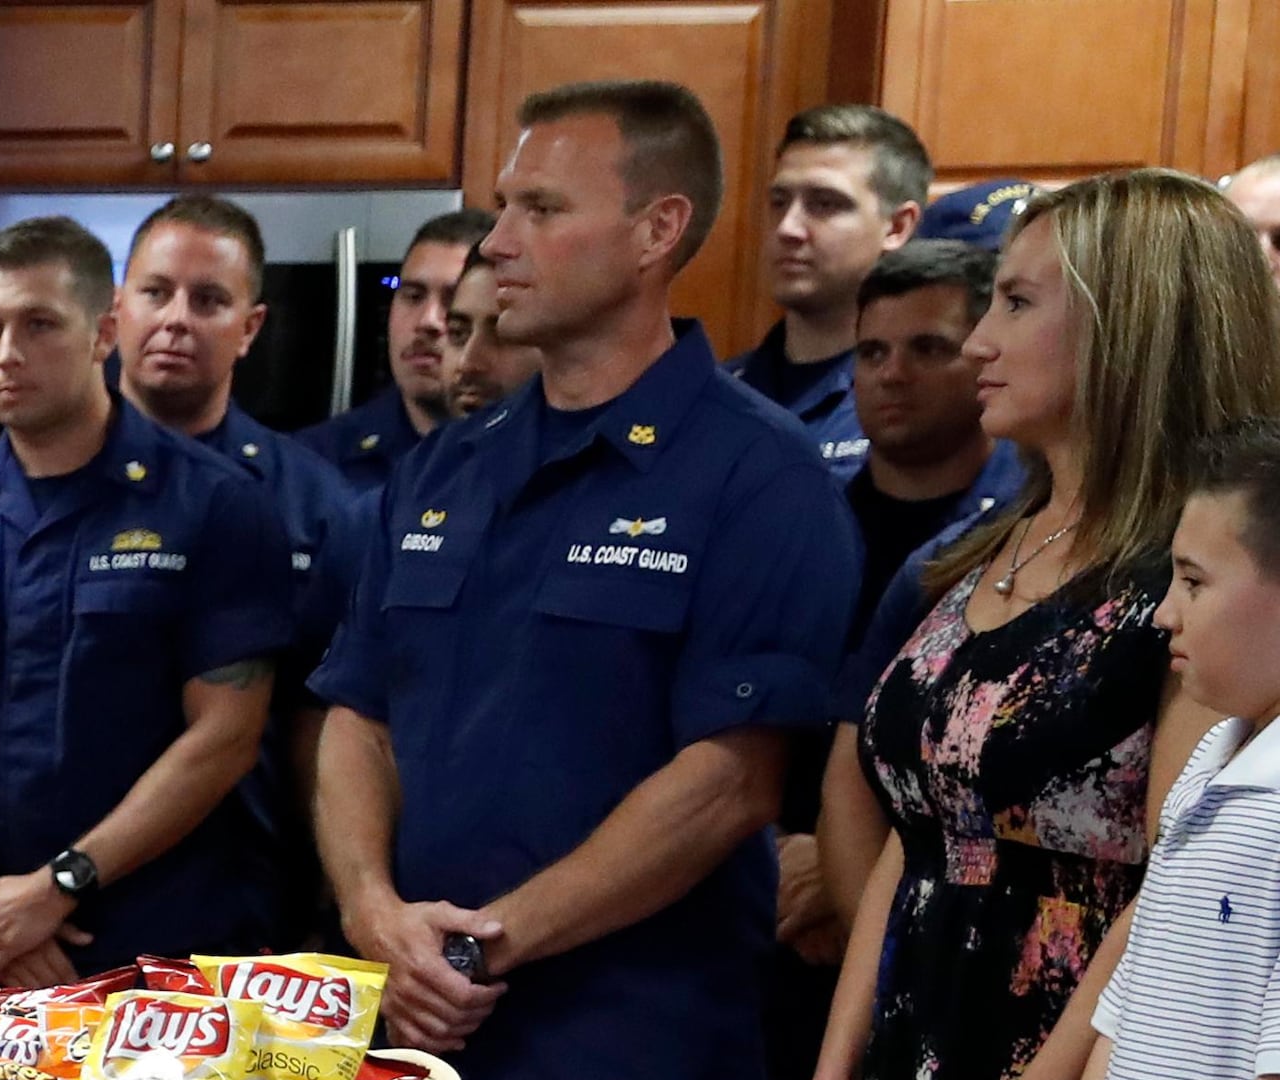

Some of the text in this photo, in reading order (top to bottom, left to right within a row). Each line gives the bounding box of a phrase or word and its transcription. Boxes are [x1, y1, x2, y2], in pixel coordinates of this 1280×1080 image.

[401, 533, 445, 552] GIBSON
[88, 552, 187, 572] U.S. COAST GUARD
[567, 544, 689, 574] U.S. COAST GUARD
[224, 961, 350, 1022] Lay's
[108, 1000, 229, 1058] Lay's
